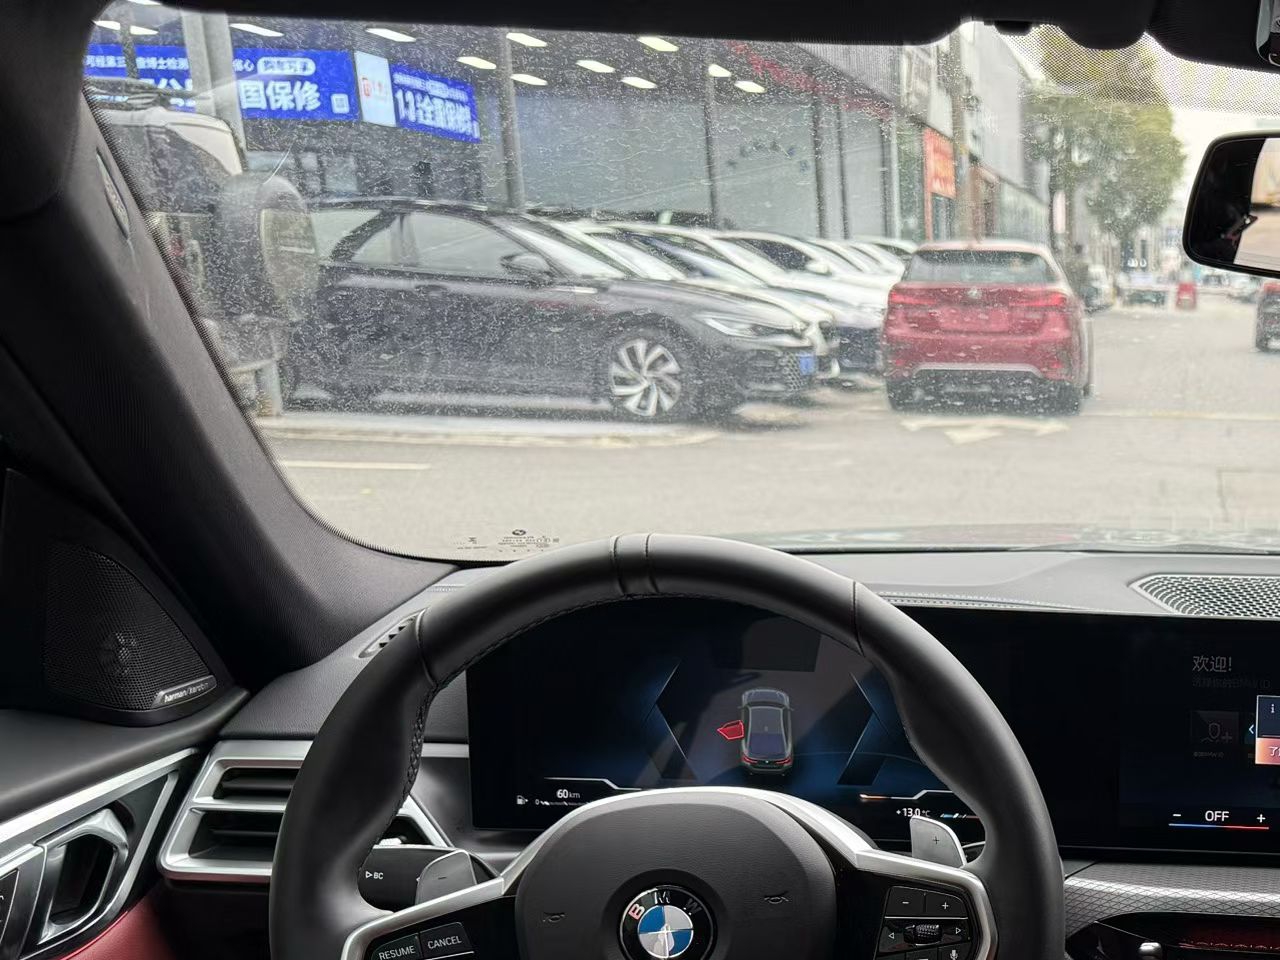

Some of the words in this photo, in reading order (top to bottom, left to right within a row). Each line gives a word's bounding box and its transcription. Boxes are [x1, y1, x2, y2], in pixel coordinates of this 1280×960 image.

[1192, 655, 1232, 673] 欢迎!
[556, 789, 569, 799] 60
[569, 791, 580, 799] km
[1204, 810, 1229, 822] OFF
[427, 935, 462, 950] CANCEL
[379, 945, 416, 960] RESUME
